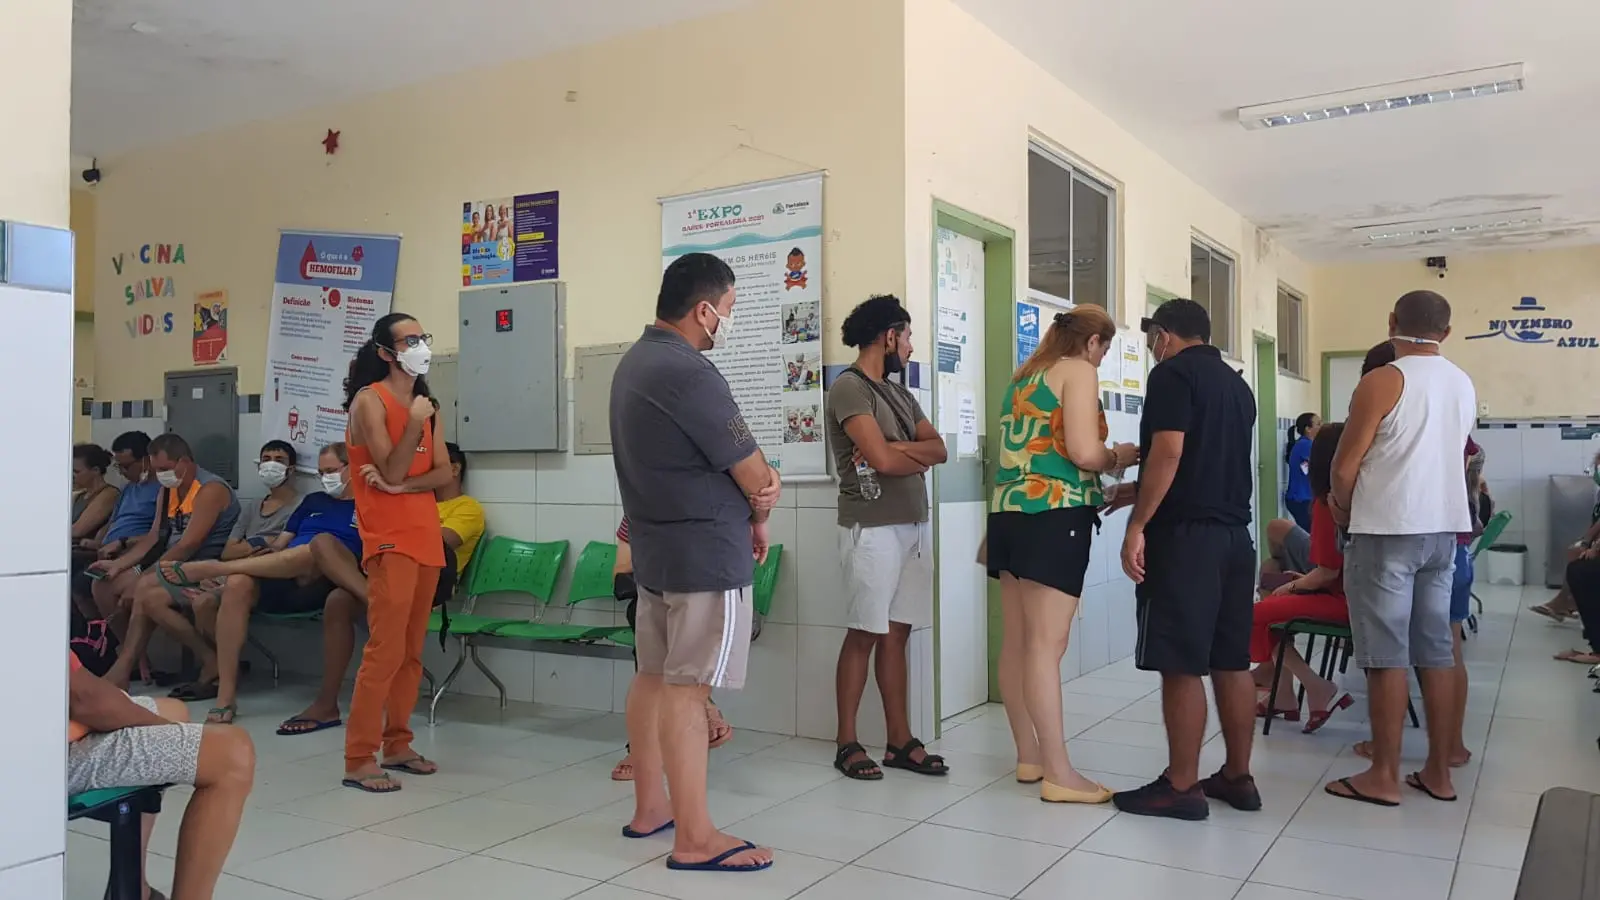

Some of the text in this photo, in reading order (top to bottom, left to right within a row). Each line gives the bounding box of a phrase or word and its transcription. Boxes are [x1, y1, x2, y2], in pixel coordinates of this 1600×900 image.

[698, 204, 742, 220] EXPO
[112, 244, 185, 275] VCINA
[310, 264, 357, 276] HEMOFILIA?
[125, 276, 175, 306] SALVA
[282, 296, 310, 306] Definição
[124, 312, 174, 338] VIDAS
[1489, 318, 1573, 330] NOVEMBRO
[1556, 336, 1599, 348] AZUL
